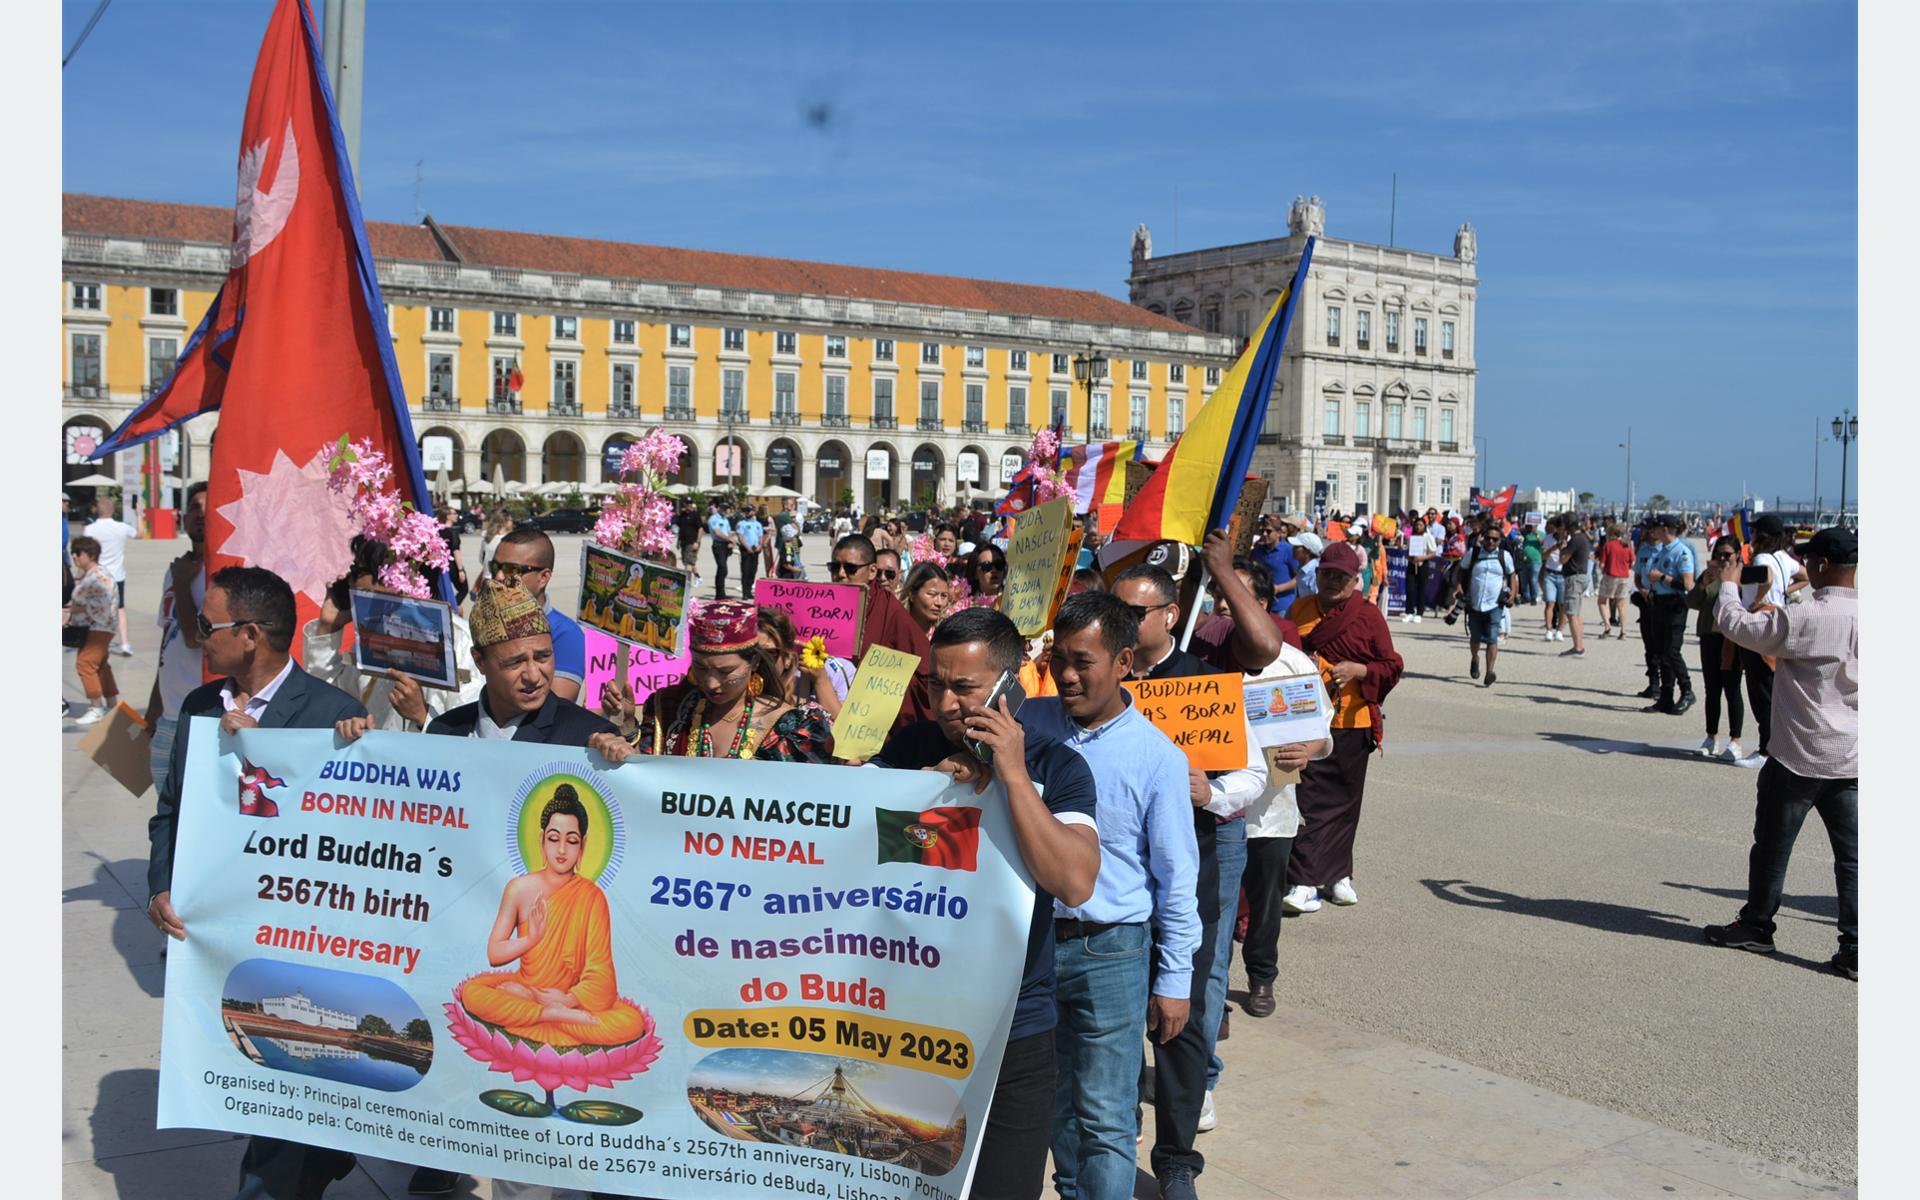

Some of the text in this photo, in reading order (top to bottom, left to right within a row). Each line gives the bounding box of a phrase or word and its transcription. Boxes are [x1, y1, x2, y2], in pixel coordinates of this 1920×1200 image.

[1005, 458, 1019, 467] CAN
[1016, 529, 1056, 554] NASCEU
[770, 585, 835, 600] BUDDHA
[808, 606, 854, 621] BORN
[867, 649, 903, 668] BUDA
[635, 673, 688, 694] NEP
[1135, 680, 1220, 700] BUDDHA
[848, 702, 870, 716] NO
[1143, 706, 1167, 722] AS
[1180, 702, 1236, 721] BORN
[844, 724, 885, 742] NEPAL
[1173, 728, 1234, 746] NEPAL
[319, 760, 462, 793] BUDDHA WAS
[300, 791, 470, 829] BORN IN NEPAL
[661, 791, 852, 830] BUDA NASCEU
[243, 830, 309, 859] Lord
[683, 831, 825, 865] NO NEPAL
[257, 874, 431, 923] 2567th birth
[763, 881, 969, 920] aniversário
[255, 923, 421, 974] anniversary
[674, 927, 942, 969] de nascimento
[739, 973, 887, 1011] do Buda
[693, 1015, 969, 1069] Date: 05 May 2023
[203, 1070, 275, 1093] Organised
[279, 1083, 301, 1100] by:
[304, 1085, 361, 1110] Principal
[365, 1099, 444, 1127] ceremonial
[449, 1117, 529, 1141] committee
[535, 1129, 551, 1143] of
[557, 1131, 593, 1147] Lord
[687, 1139, 747, 1159] 2567th
[753, 1149, 854, 1178] anniversary,
[861, 1159, 910, 1189] Lisbon
[915, 1176, 957, 1200] Portu
[224, 1096, 304, 1122] Organizado
[308, 1111, 341, 1129] pela:
[345, 1117, 393, 1139] Comitê
[398, 1127, 415, 1143] de
[419, 1132, 498, 1158] cerimonial
[504, 1149, 572, 1169] principal
[578, 1157, 599, 1171] de
[661, 1162, 757, 1185] aniversário
[763, 1170, 831, 1198] deBuda,
